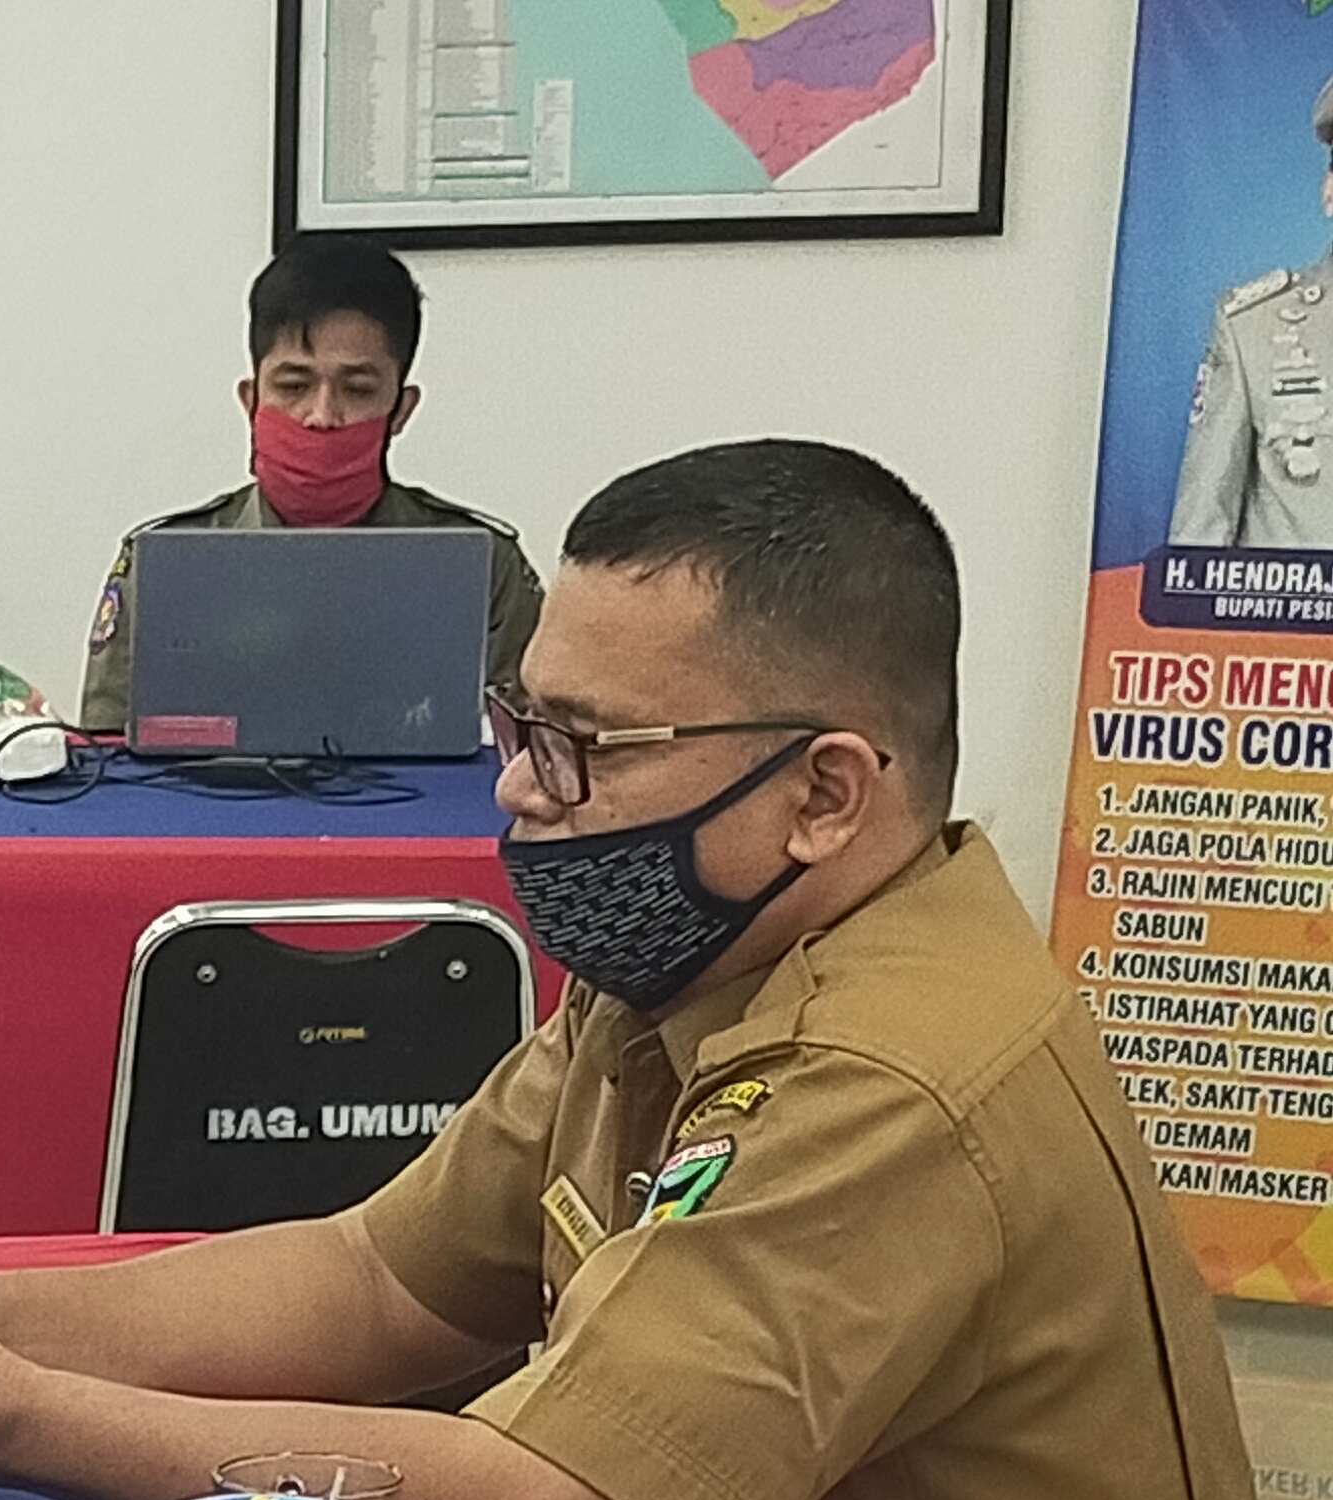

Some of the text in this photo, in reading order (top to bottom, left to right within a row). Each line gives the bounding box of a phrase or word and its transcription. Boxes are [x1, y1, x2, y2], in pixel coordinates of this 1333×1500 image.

[1166, 558, 1196, 590] H.
[1214, 597, 1284, 620] BUPATI
[1113, 656, 1333, 709] TIPS MEN
[1093, 713, 1333, 769] VIRUS COR
[1101, 787, 1325, 827] 1. JANGAN PANIK,
[1095, 828, 1333, 867] 2. JAGA POLA HIDU
[1090, 868, 1325, 908] 3. RAJIN MENCUCI
[1116, 912, 1206, 942] SABUN
[1081, 950, 1333, 993] 4. KONSUMSI MAKA
[1107, 993, 1241, 1028] ISTIRAHAT
[1248, 1003, 1317, 1034] YANG
[1104, 1034, 1333, 1077] WASPADA TERHAD
[1117, 1076, 1333, 1118] LEK, SAKIT TENG
[207, 1103, 457, 1141] BAG. UMUM
[1154, 1121, 1253, 1153] DEMAM
[1151, 1161, 1331, 1202] KAN MASKER
